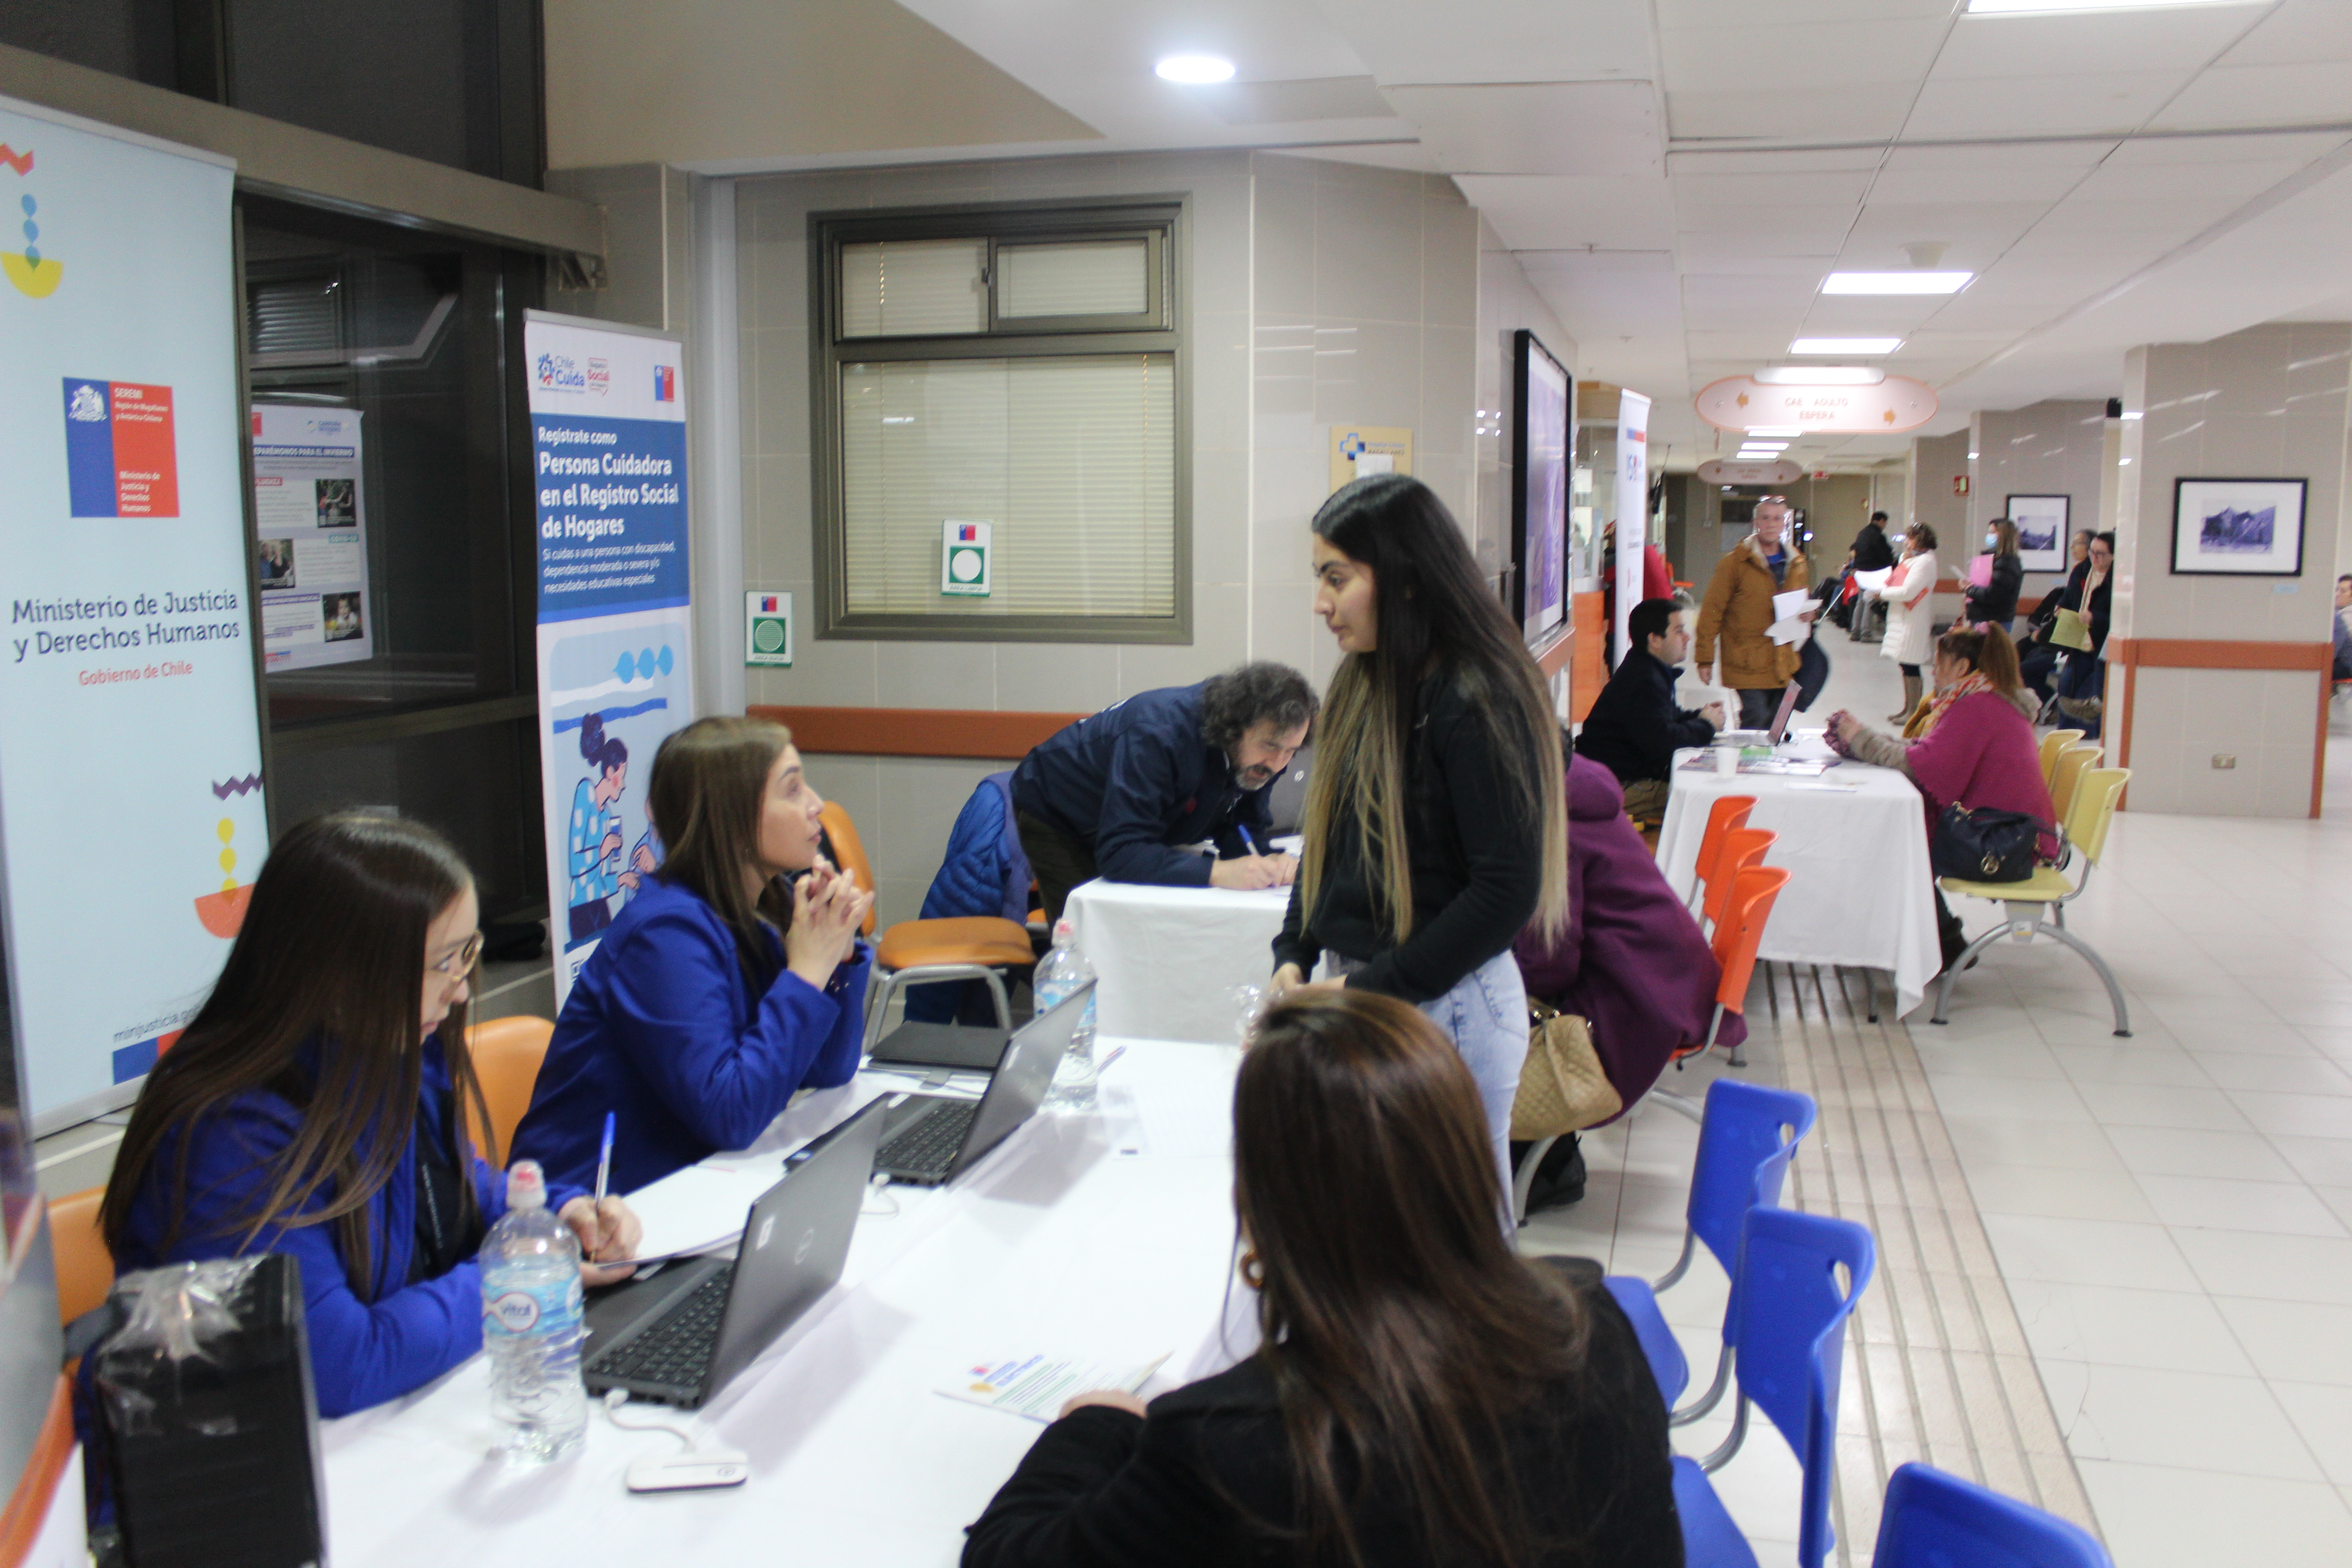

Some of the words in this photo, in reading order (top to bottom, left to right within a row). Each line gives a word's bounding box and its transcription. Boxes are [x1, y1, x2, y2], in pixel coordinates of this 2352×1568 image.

[556, 369, 585, 386] Cuida
[588, 369, 609, 381] Social
[114, 388, 143, 400] SEREMI
[1785, 397, 1803, 407] CAE
[1814, 397, 1849, 407] ADULTO
[1799, 411, 1835, 420] ESPERA
[538, 426, 590, 447] Regístrate
[590, 431, 617, 446] como
[254, 446, 298, 456] EPARÉMONOS
[539, 451, 600, 475] Persona
[602, 453, 672, 476] Cuidadora
[119, 471, 151, 480] Ministerio
[121, 482, 145, 490] Justicia
[145, 484, 150, 493] y
[121, 492, 151, 502] Derechos
[540, 488, 561, 507] en
[563, 483, 578, 507] el
[580, 483, 639, 511] Registro
[641, 483, 679, 505] Social
[122, 504, 151, 513] Humanos
[542, 515, 562, 539] de
[565, 514, 624, 542] Hogares
[543, 548, 551, 561] Si
[552, 548, 575, 561] cuidas
[575, 549, 580, 559] a
[581, 548, 593, 559] una
[594, 546, 621, 559] persona
[621, 545, 634, 556] con
[635, 541, 676, 556] discapacidad,
[544, 563, 589, 579] dependencia
[590, 560, 622, 573] moderada
[623, 561, 628, 570] o
[629, 559, 649, 570] severa
[650, 556, 660, 572] y/o
[544, 578, 588, 594] necesidades
[588, 576, 622, 589] educativas
[623, 573, 656, 588] especiales
[12, 594, 127, 623] Ministerio
[133, 593, 158, 616] de
[164, 589, 238, 613] Justicia
[14, 637, 29, 662] y
[36, 627, 141, 655] Derechos
[147, 622, 240, 645] Humanos
[79, 668, 141, 686] Gobierno
[143, 664, 158, 679] de
[160, 661, 193, 677] Chile
[503, 1302, 530, 1316] vital
